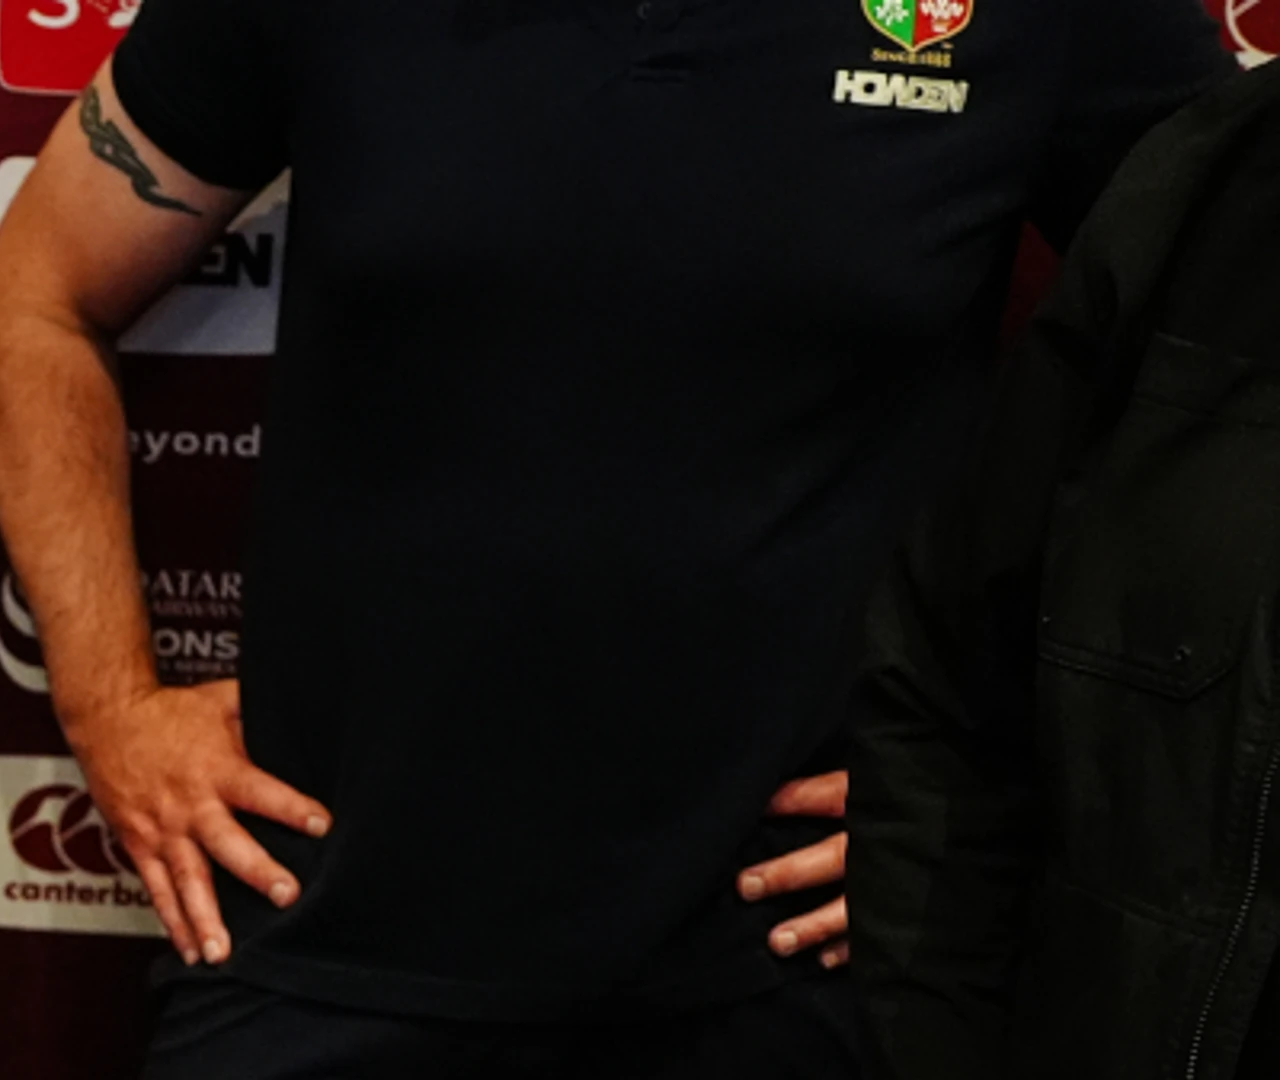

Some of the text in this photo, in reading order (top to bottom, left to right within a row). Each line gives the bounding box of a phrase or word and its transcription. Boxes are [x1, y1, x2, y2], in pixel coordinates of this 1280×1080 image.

[833, 69, 970, 113] HOWDEN
[141, 569, 243, 599] ATAR
[153, 628, 240, 660] ONS
[3, 878, 155, 907] canterbu
